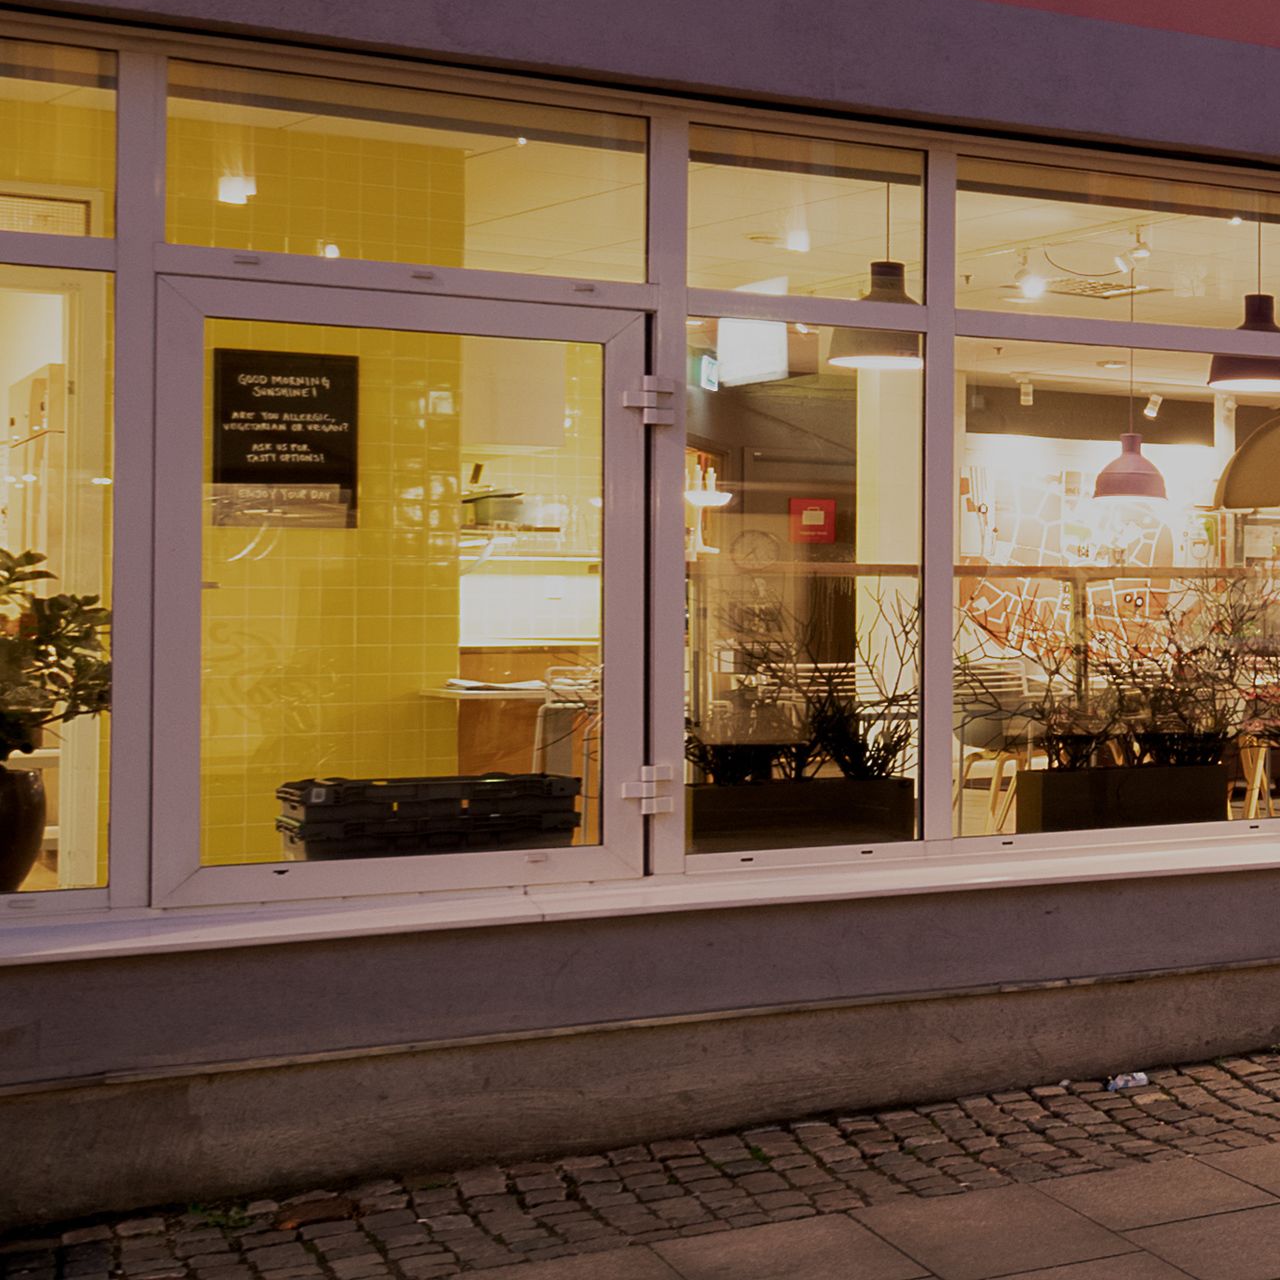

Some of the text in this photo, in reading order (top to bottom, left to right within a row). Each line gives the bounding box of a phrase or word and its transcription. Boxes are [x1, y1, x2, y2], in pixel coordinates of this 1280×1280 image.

[238, 374, 330, 389] GOOD MORNING
[231, 411, 256, 420] ARE
[261, 412, 280, 420] YOU
[223, 422, 349, 433] VEGETARIAN OR VEGAN?
[251, 443, 311, 451] ASK US FOR
[246, 453, 325, 463] TASTY OPTIONS!
[238, 488, 332, 500] ENJOY YOUR DAY
